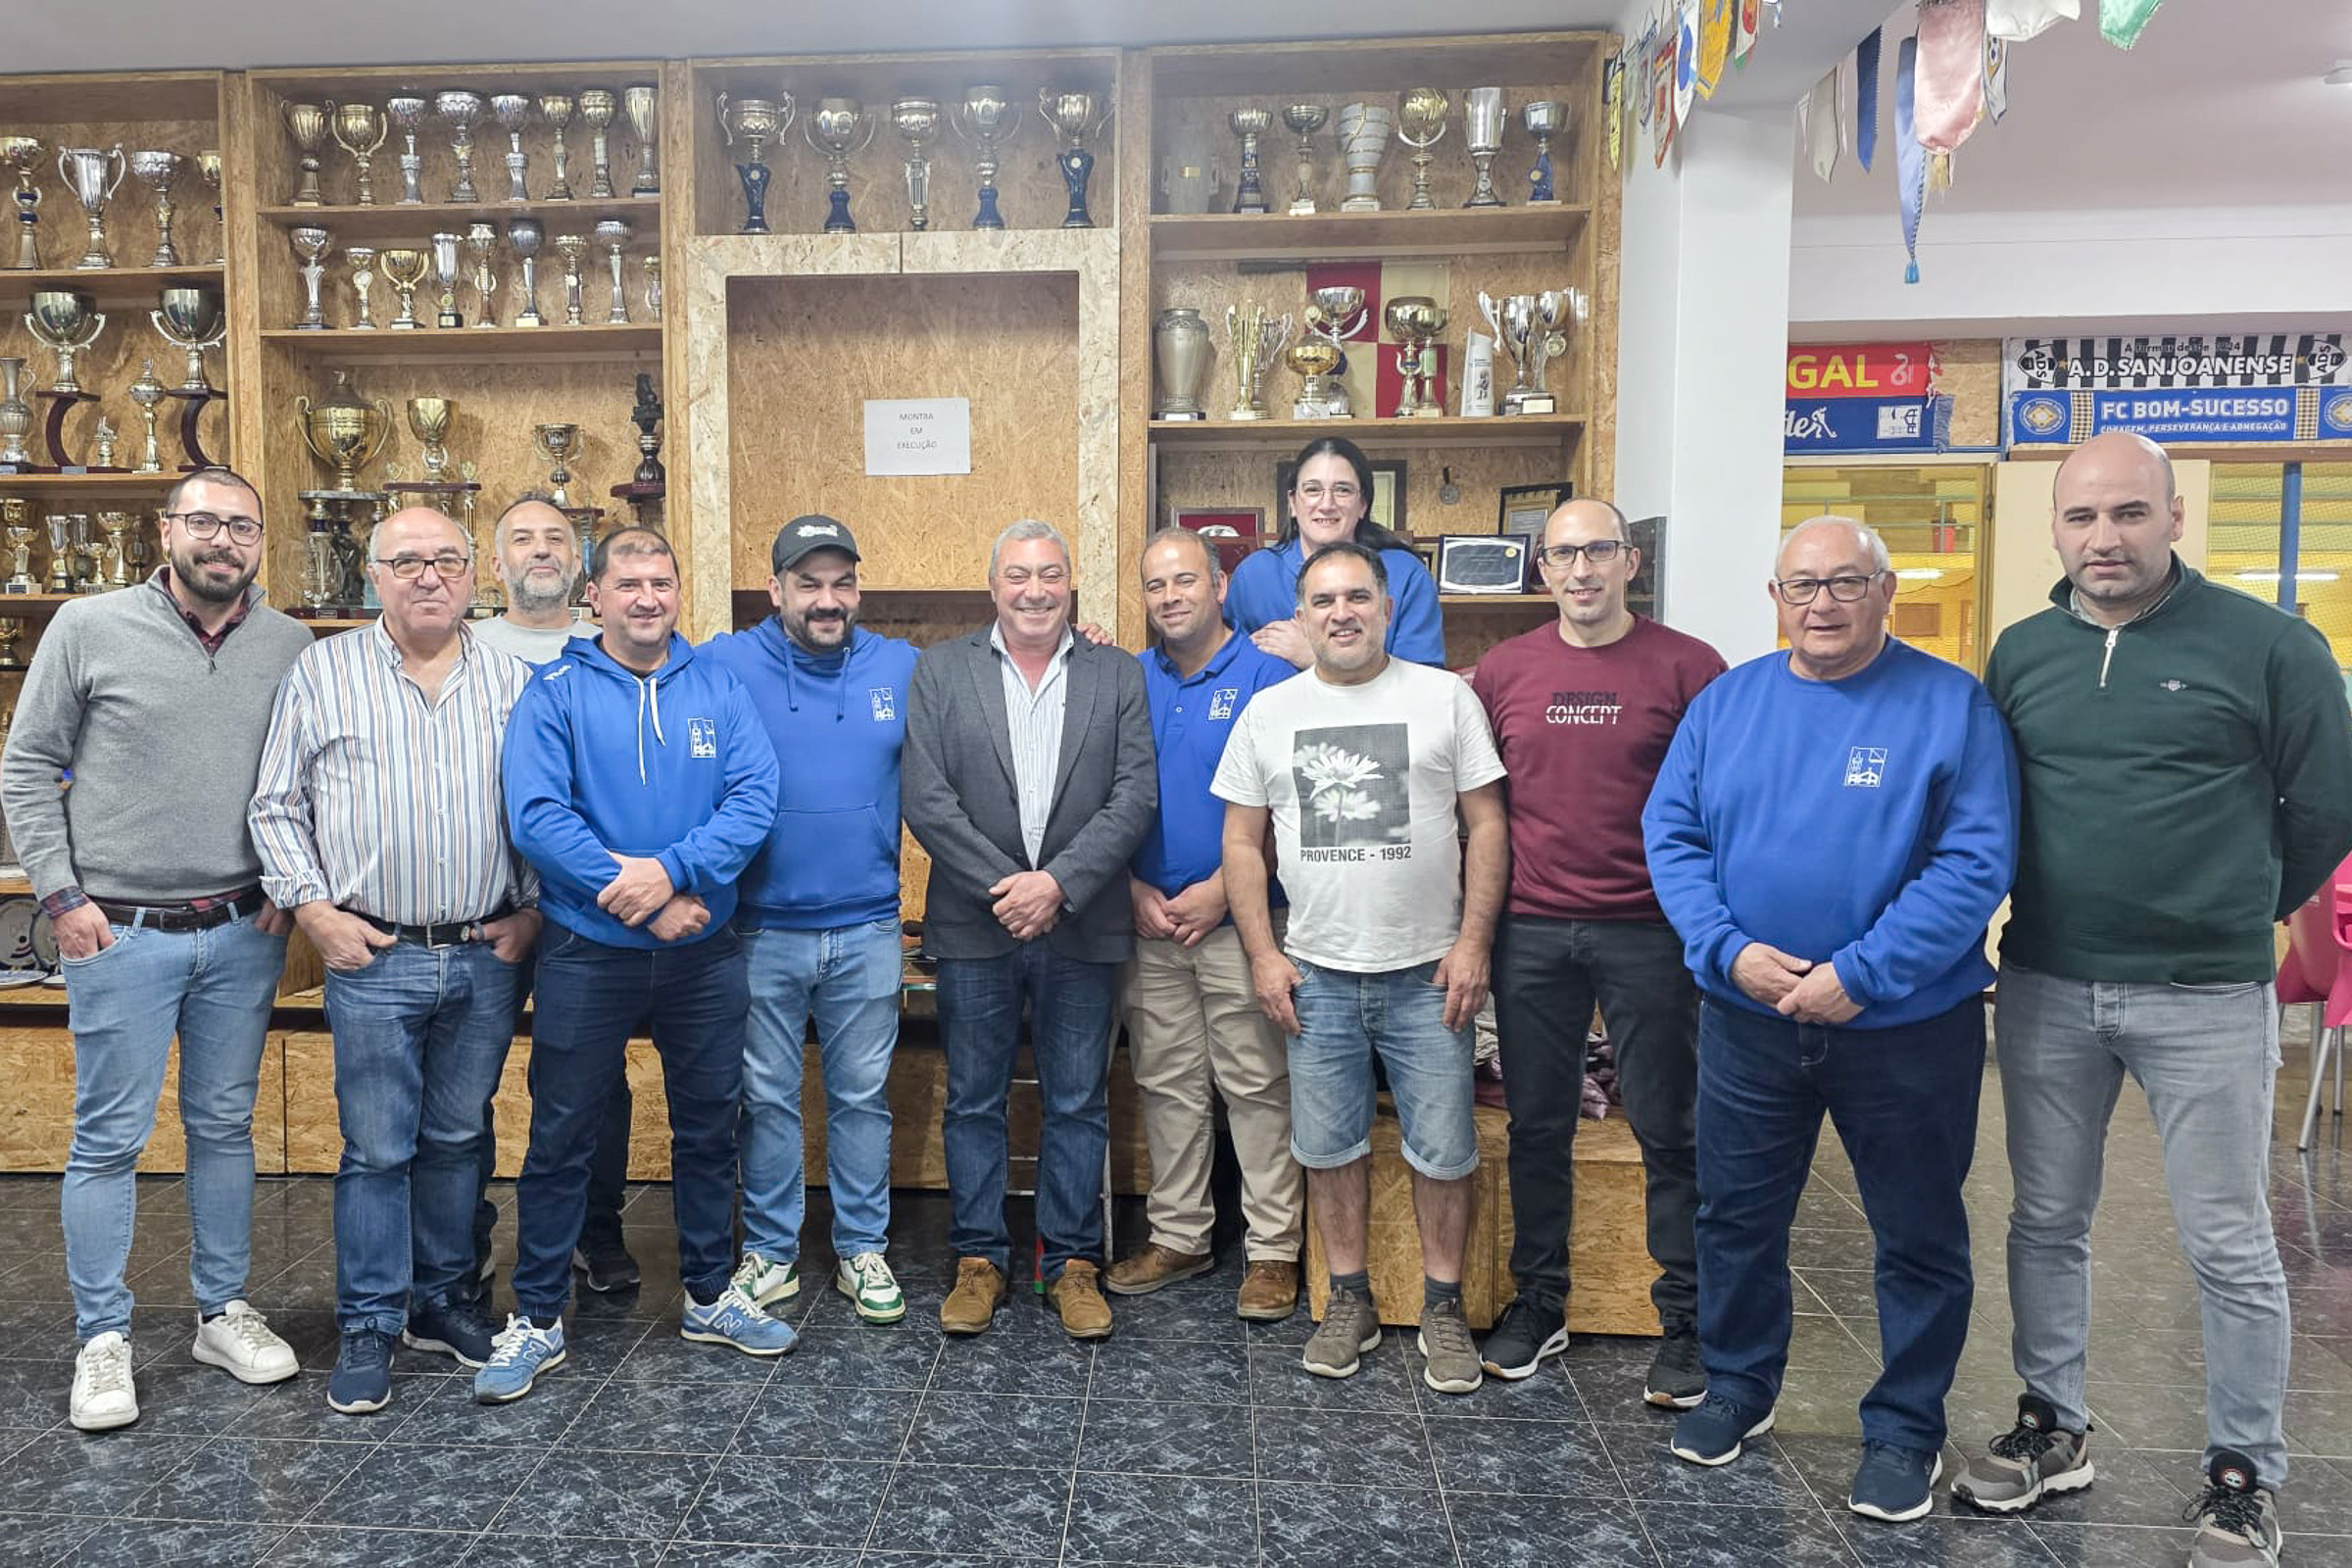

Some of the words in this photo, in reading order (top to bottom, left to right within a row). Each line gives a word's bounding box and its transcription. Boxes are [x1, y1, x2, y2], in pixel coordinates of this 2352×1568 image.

[2034, 350, 2048, 379] ADS
[2317, 344, 2331, 373] ADS
[1788, 355, 1880, 389] GAL
[899, 413, 934, 421] MONTRA
[2101, 402, 2129, 419] FC
[2133, 399, 2288, 417] BOM-SUCESSO
[897, 440, 937, 450] EXECUÇÃO
[1545, 705, 1623, 725] CONCEPT
[1300, 848, 1366, 862] PROVENCE
[1380, 846, 1411, 860] 1992
